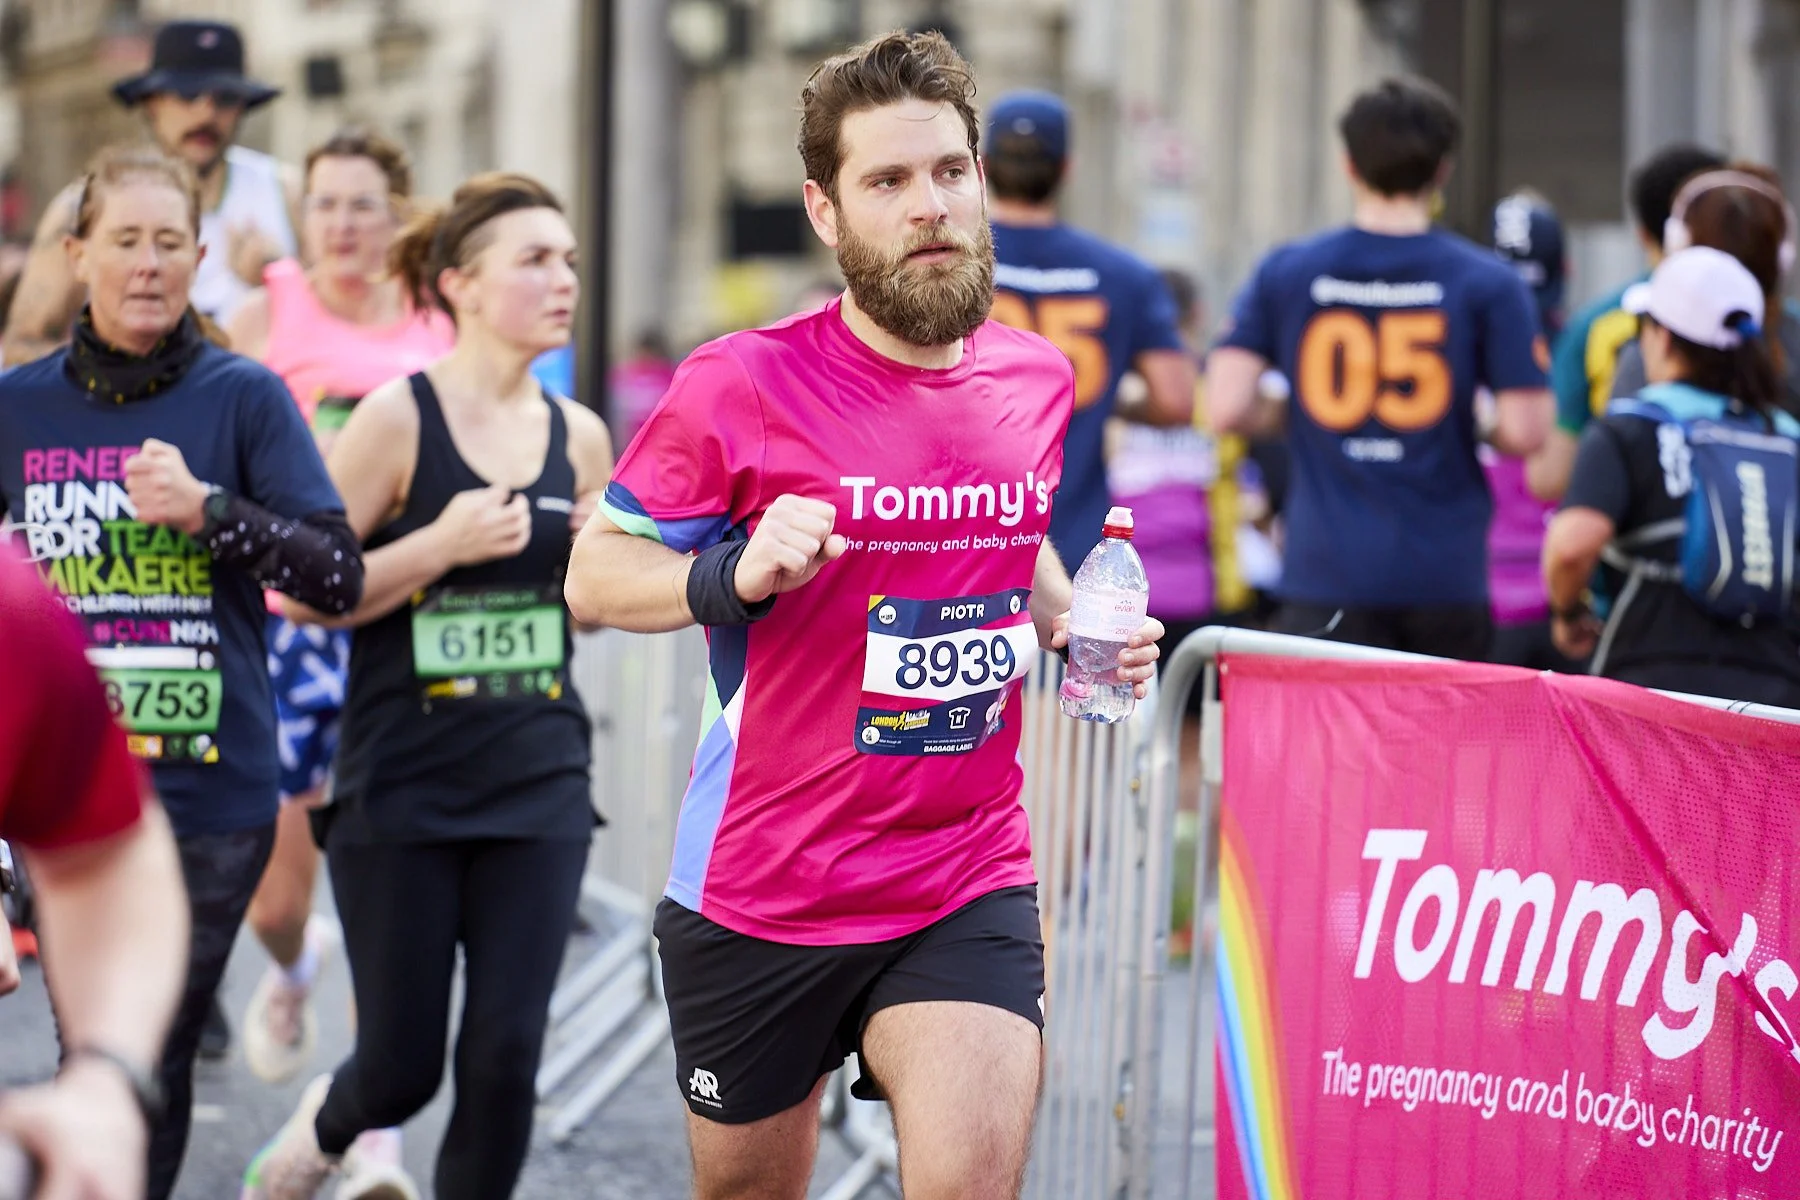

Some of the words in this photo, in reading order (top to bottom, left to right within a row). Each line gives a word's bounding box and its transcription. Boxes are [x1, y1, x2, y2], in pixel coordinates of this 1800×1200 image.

[1298, 309, 1452, 432] 05
[839, 471, 1049, 527] Tommy's
[846, 538, 863, 551] he
[868, 539, 939, 555] pregnancy
[941, 536, 969, 551] and
[972, 534, 1007, 550] baby
[1010, 531, 1043, 547] charity
[940, 603, 985, 621] PIOTR
[440, 619, 537, 662] 6151
[895, 634, 1016, 690] 8939
[871, 715, 898, 727] LONDON
[924, 744, 955, 753] BAGGAGE
[956, 743, 973, 752] LABEL
[1353, 828, 1800, 1065] Tommy's
[1322, 1046, 1361, 1098] The
[1365, 1063, 1502, 1121] pregnancy
[1507, 1069, 1568, 1119] and
[1576, 1072, 1656, 1148] baby
[1661, 1094, 1785, 1173] charity
